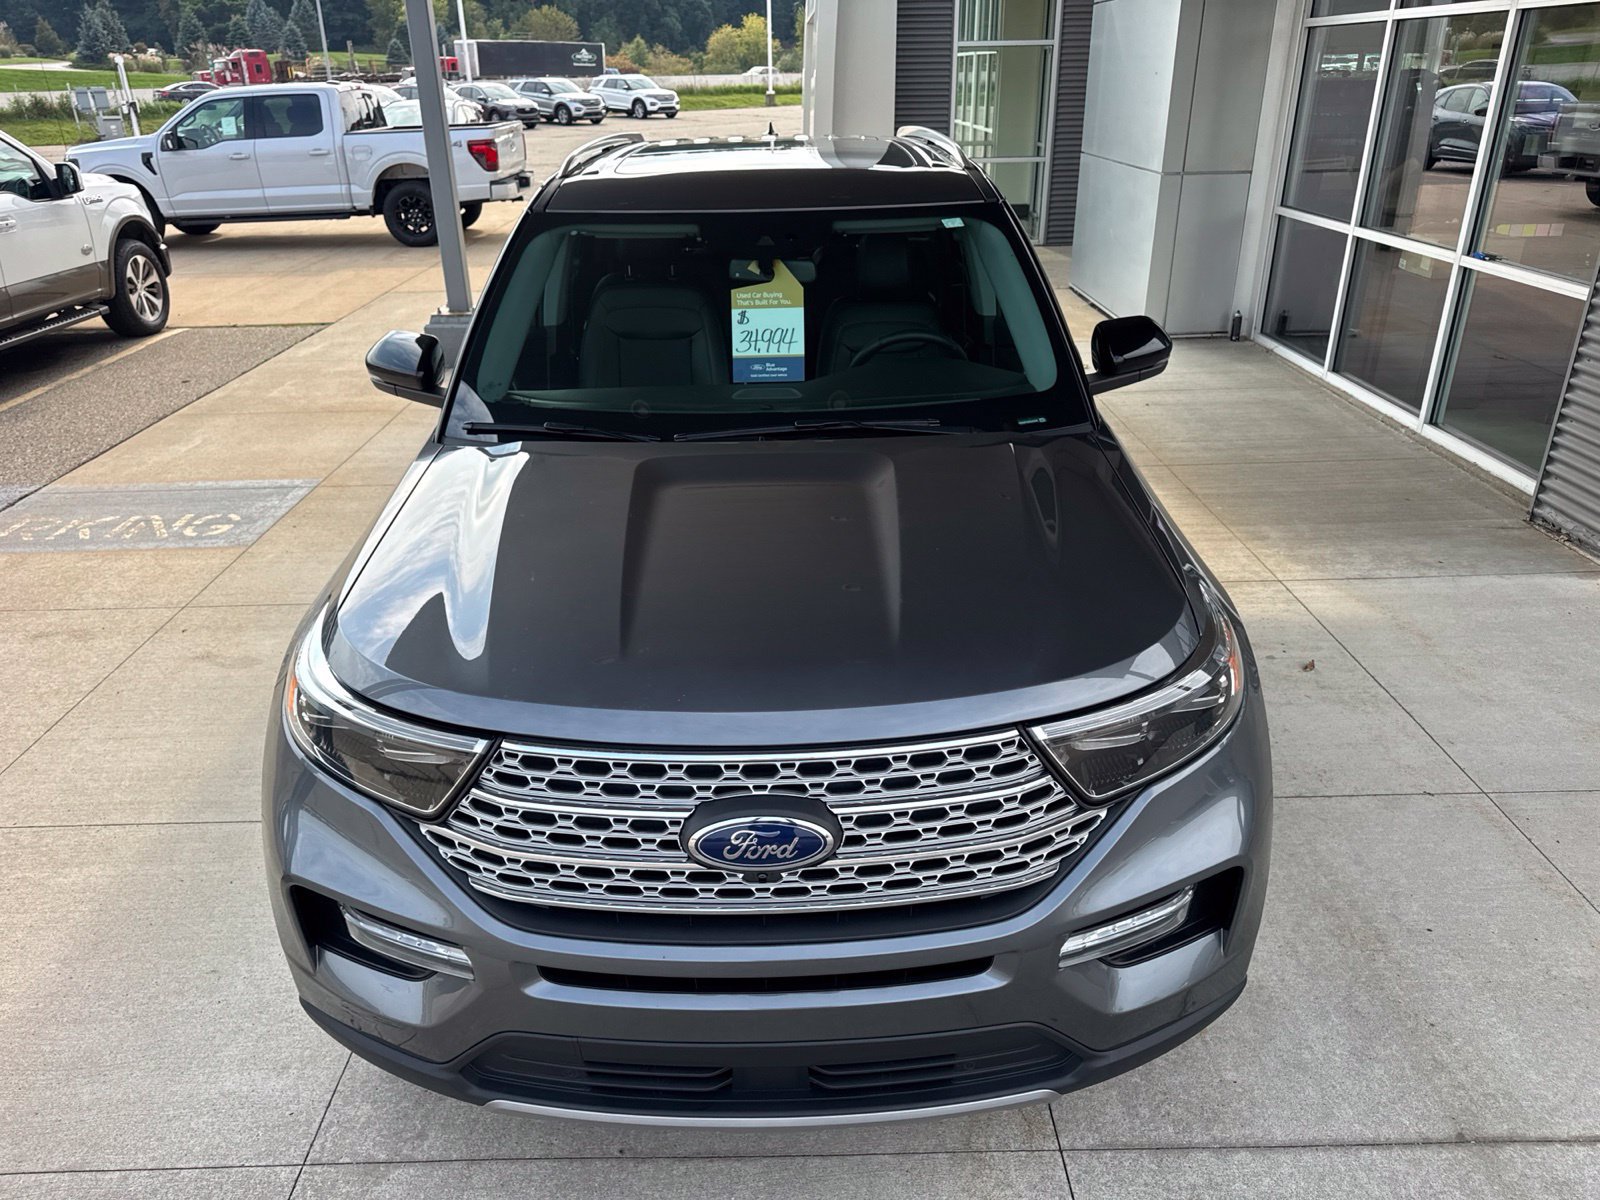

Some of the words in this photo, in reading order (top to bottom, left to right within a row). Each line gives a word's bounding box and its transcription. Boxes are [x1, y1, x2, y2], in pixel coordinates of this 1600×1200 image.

[763, 291, 783, 299] Buying
[737, 310, 750, 325] $
[723, 829, 799, 860] Ford
